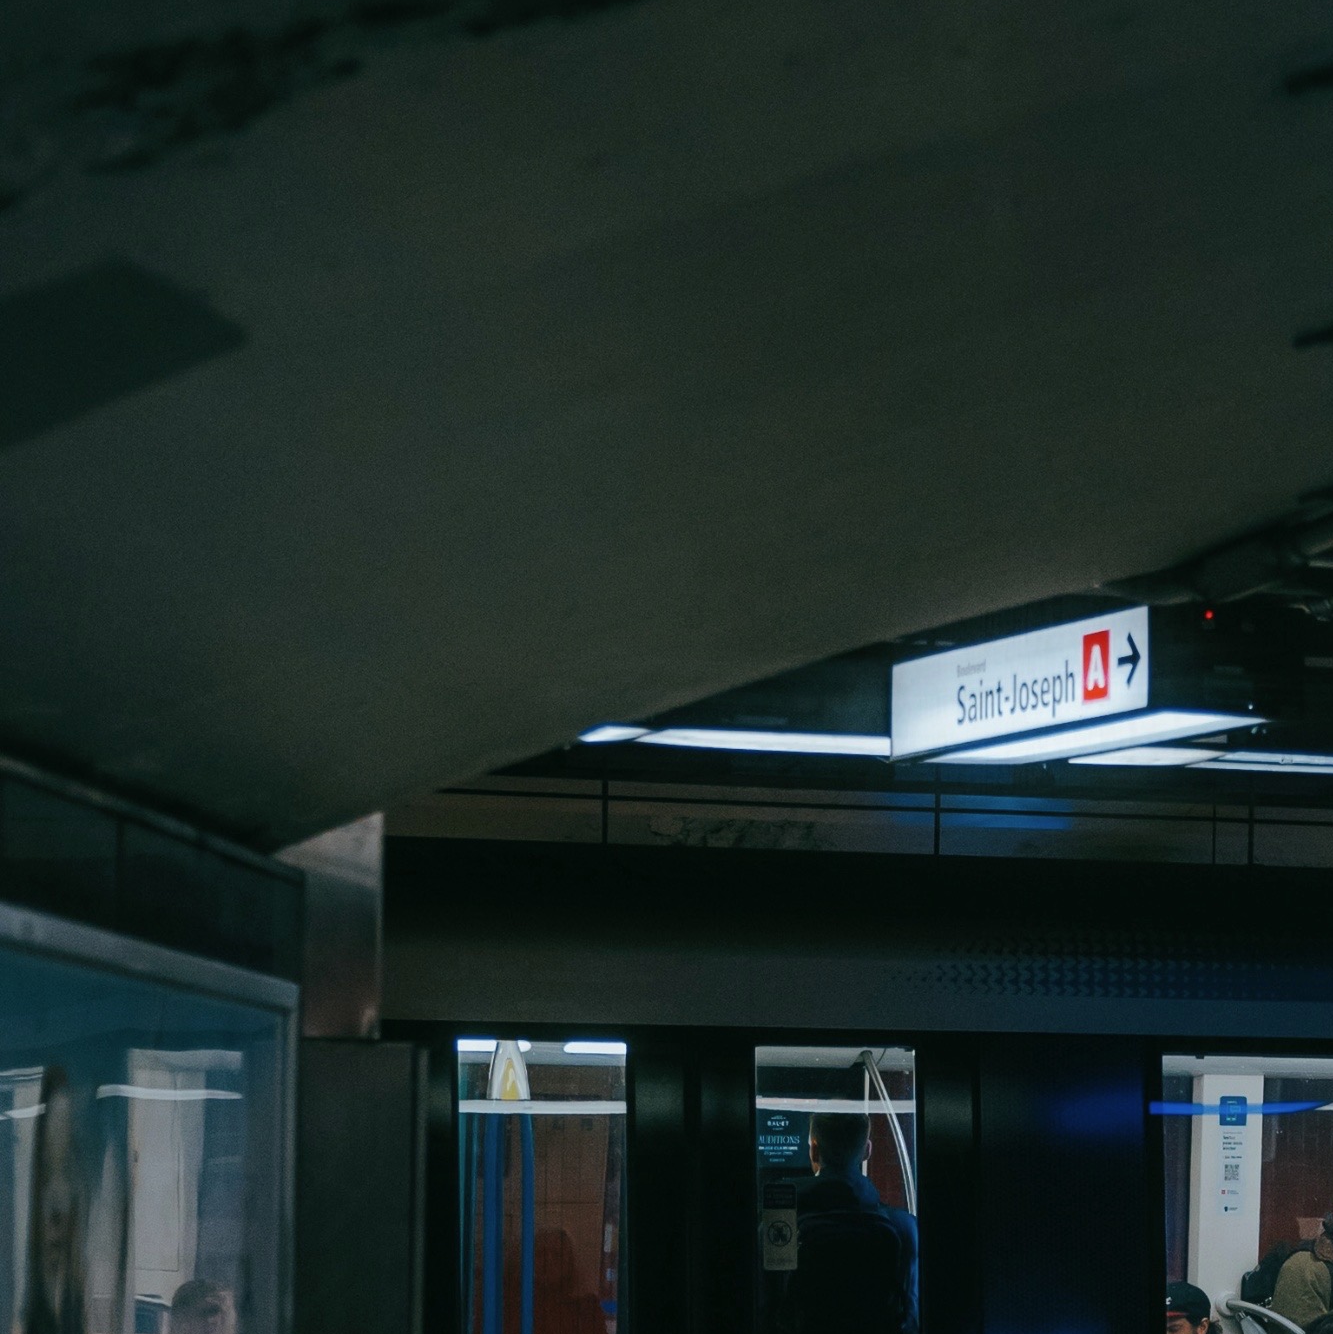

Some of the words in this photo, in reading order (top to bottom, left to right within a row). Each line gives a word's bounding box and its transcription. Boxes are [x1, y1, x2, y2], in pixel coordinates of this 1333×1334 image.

[957, 660, 1075, 724] Saint-Joseph
[1086, 643, 1107, 691] A
[758, 1135, 800, 1144] AUDITIONS
